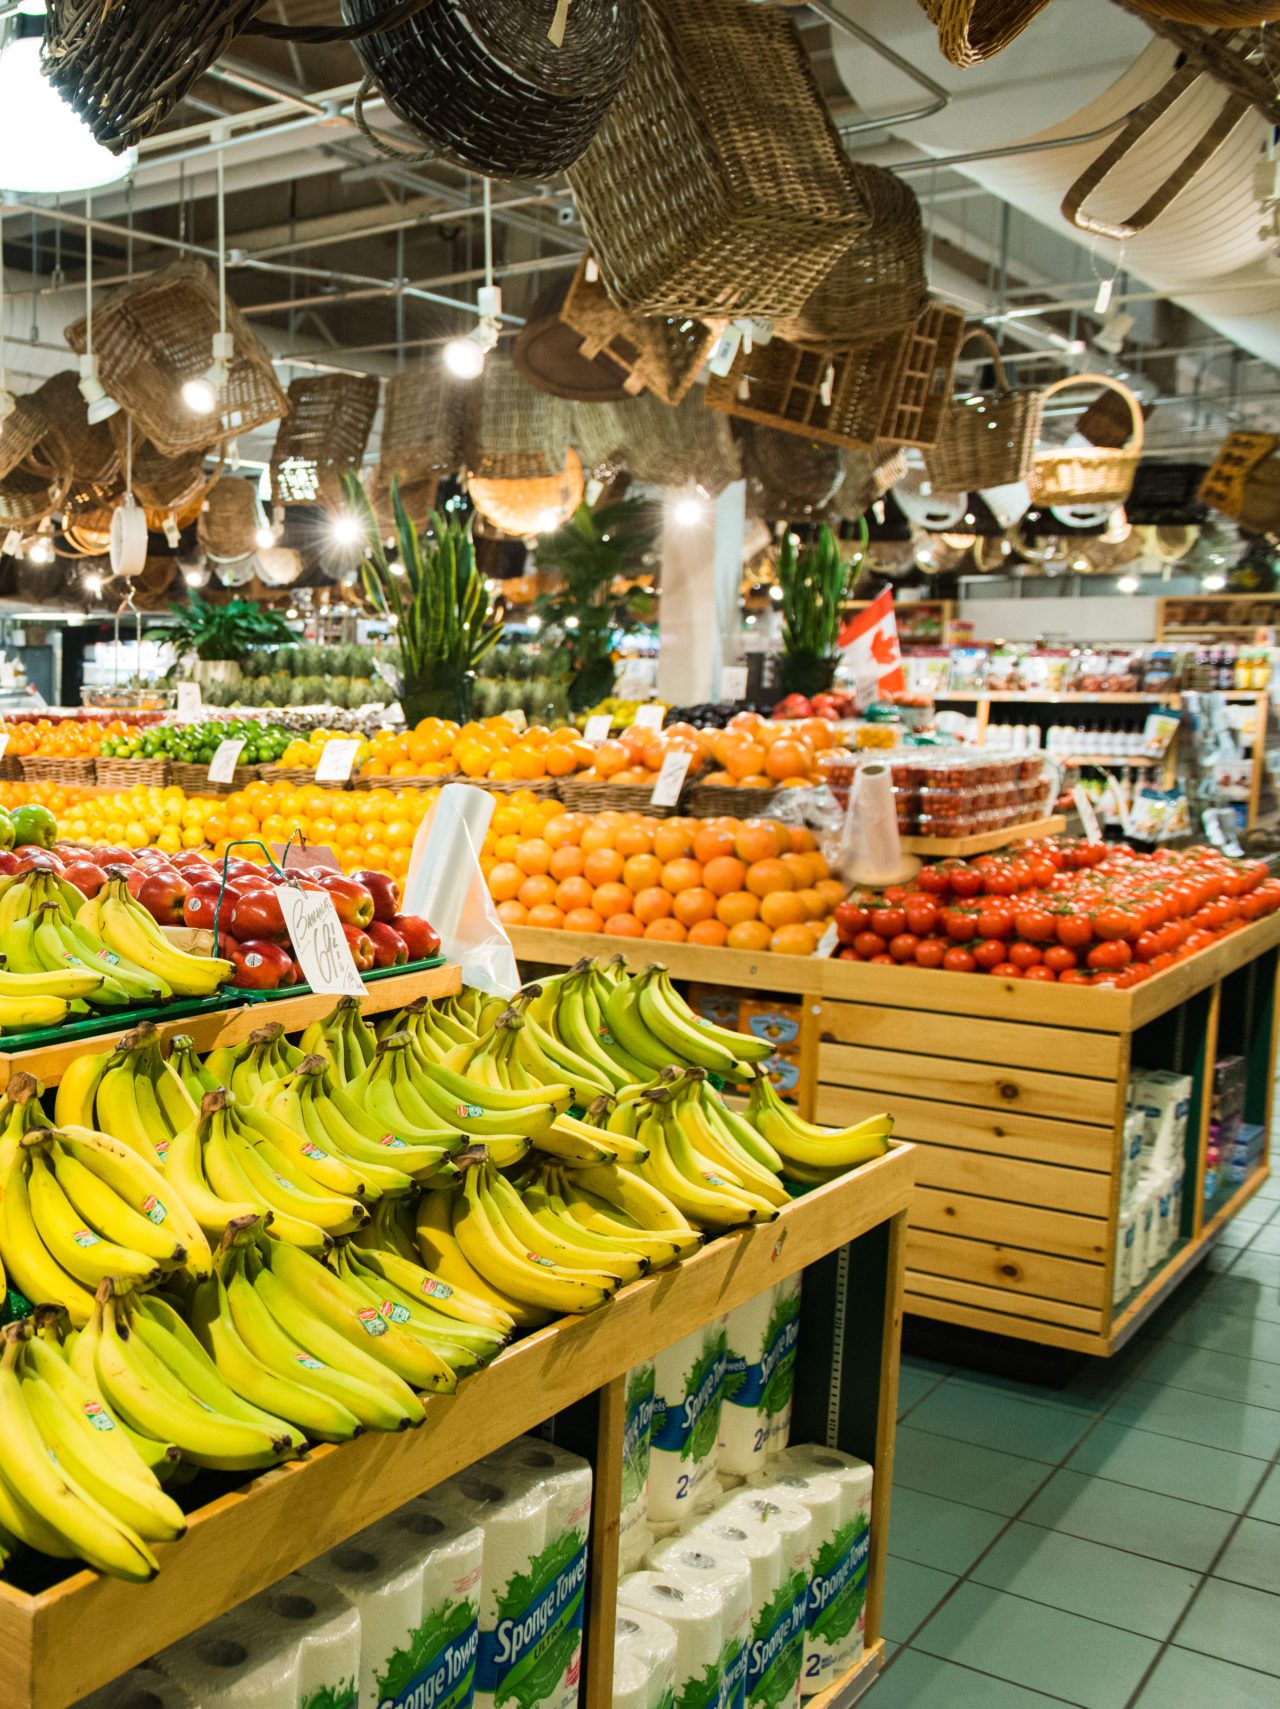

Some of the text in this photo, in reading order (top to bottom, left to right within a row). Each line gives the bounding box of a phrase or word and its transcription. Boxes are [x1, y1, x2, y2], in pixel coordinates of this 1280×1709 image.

[675, 1474, 690, 1500] 2
[808, 1554, 852, 1610] Sponge
[493, 1591, 554, 1664] Sponge
[748, 1618, 792, 1675] Sponge
[804, 1652, 821, 1678] 2
